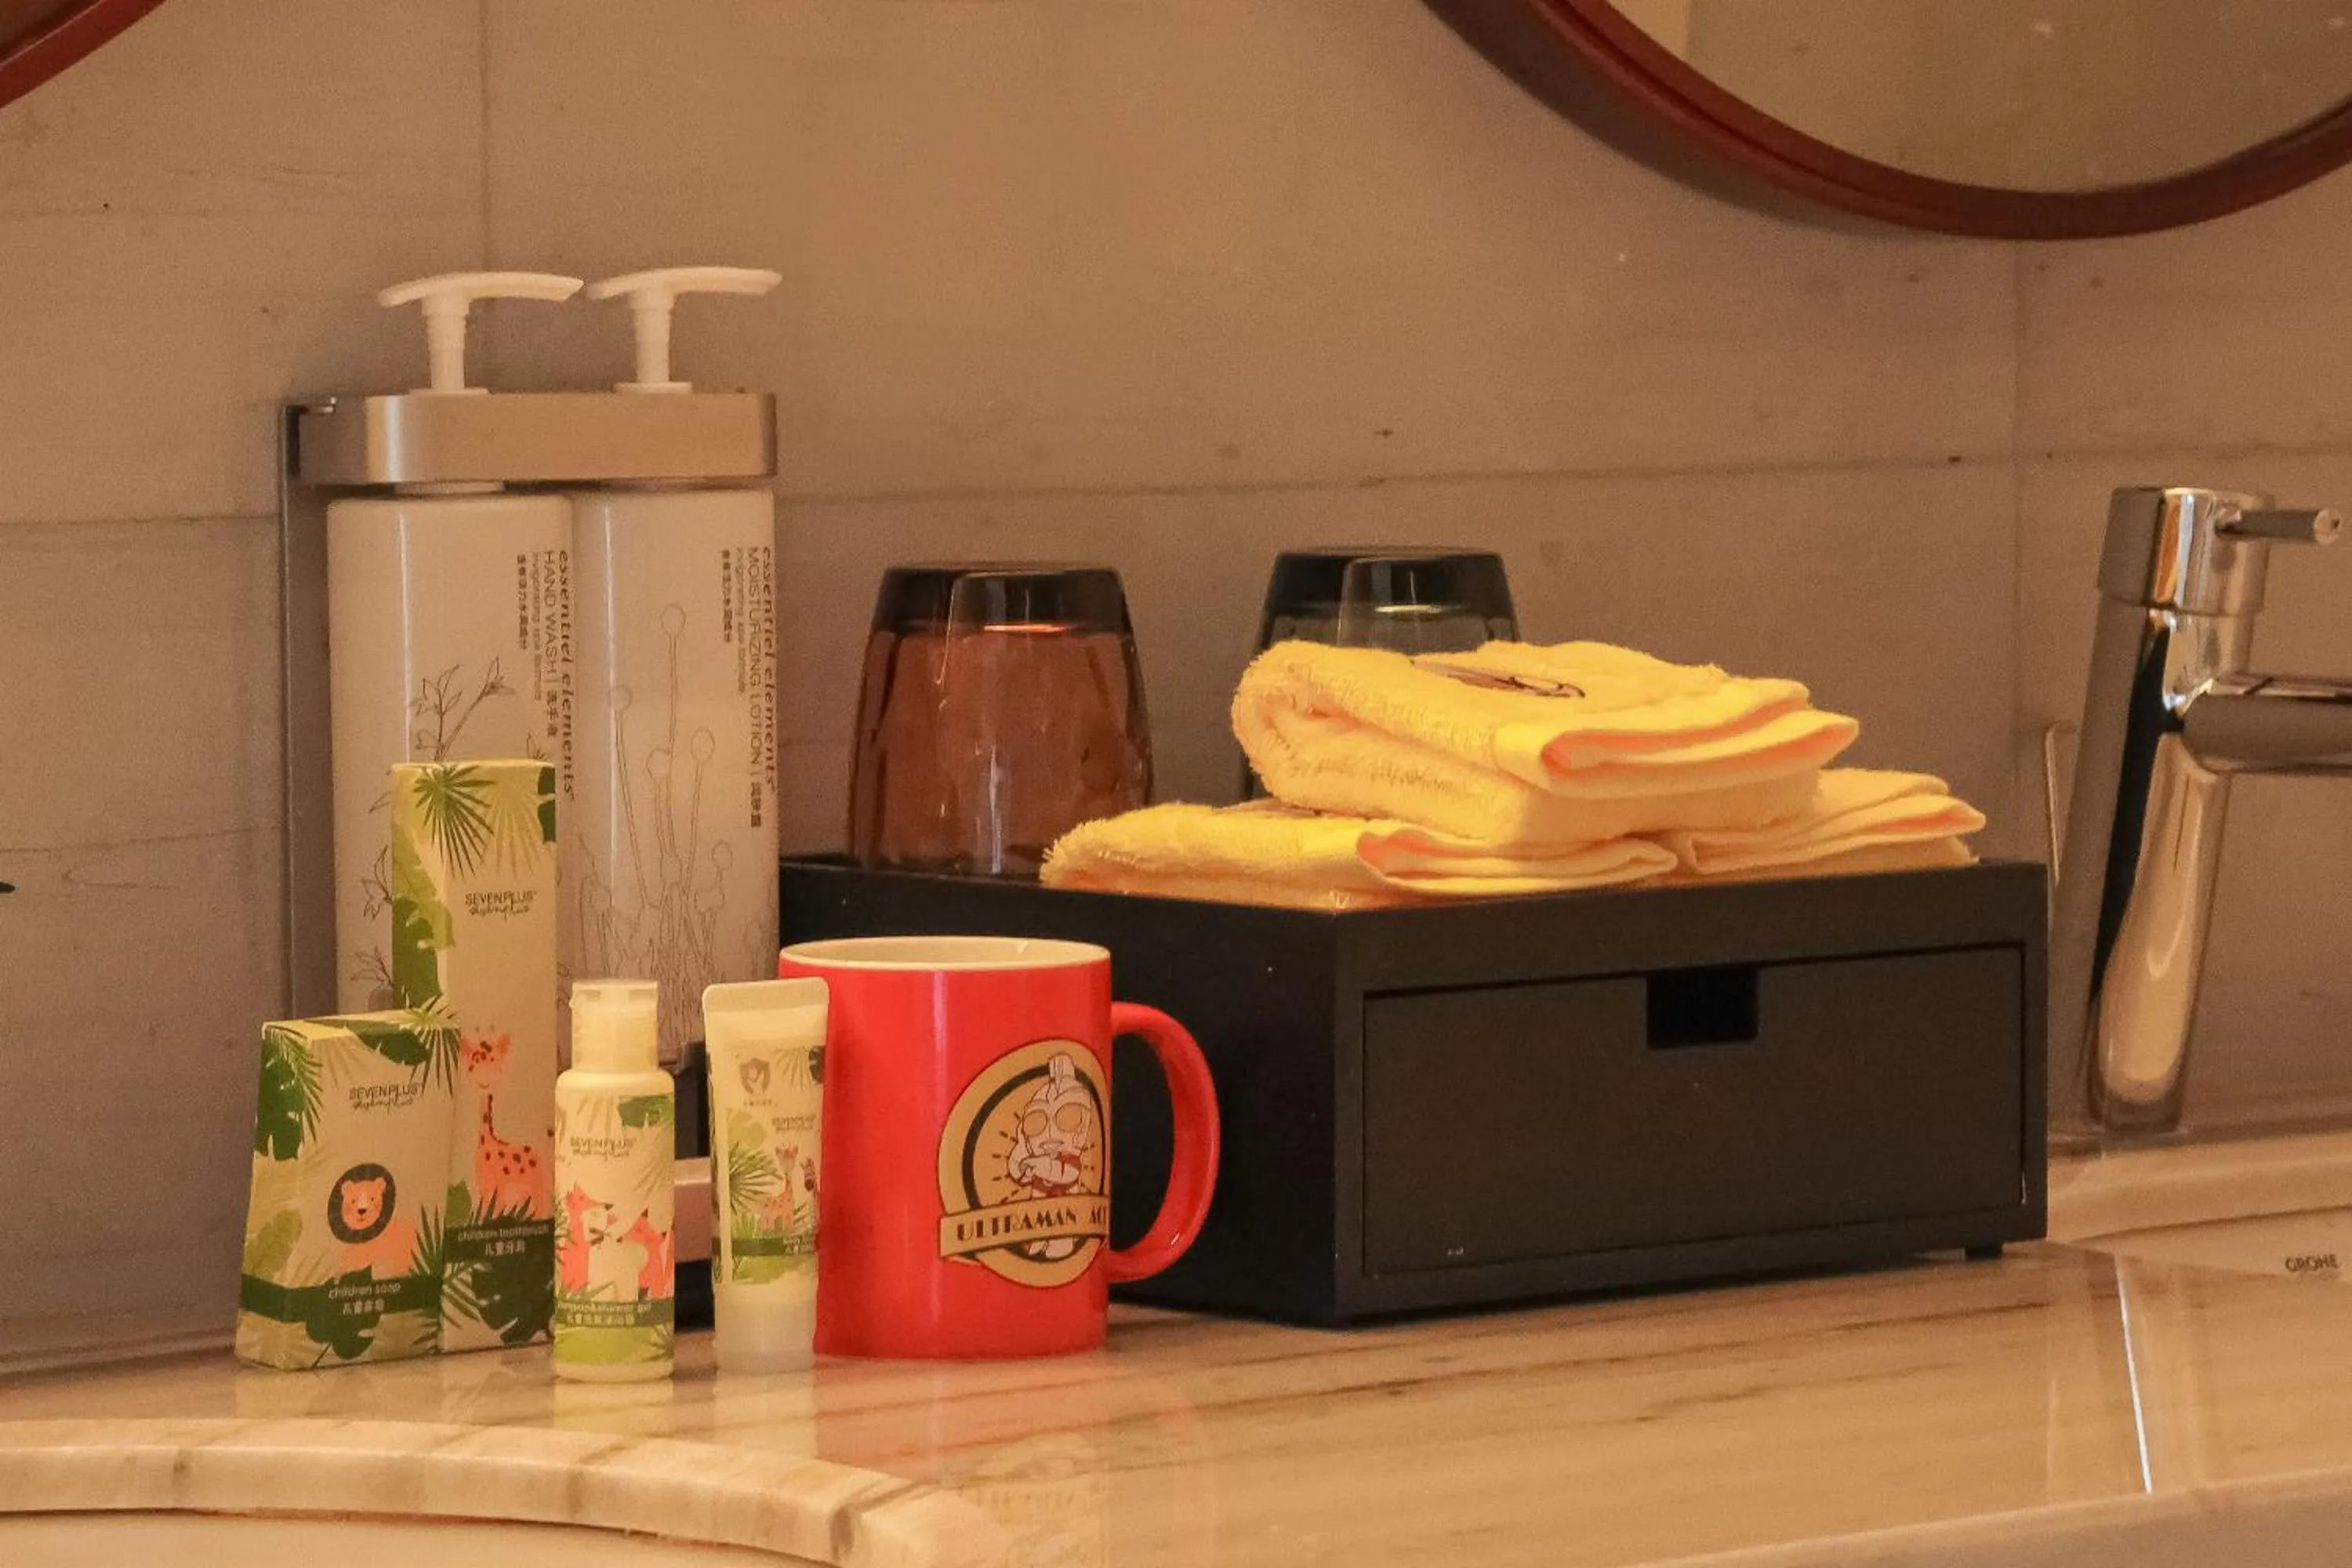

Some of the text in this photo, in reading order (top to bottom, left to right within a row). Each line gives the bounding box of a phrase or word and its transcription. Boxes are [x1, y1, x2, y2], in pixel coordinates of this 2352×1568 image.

[544, 550, 557, 673] HAND WASH
[559, 550, 575, 801] essentiel elements
[763, 546, 776, 792] essentiel elements
[750, 693, 762, 765] LOTION
[957, 1204, 1077, 1241] ULTRAMAN
[2285, 1254, 2339, 1272] GROHE
